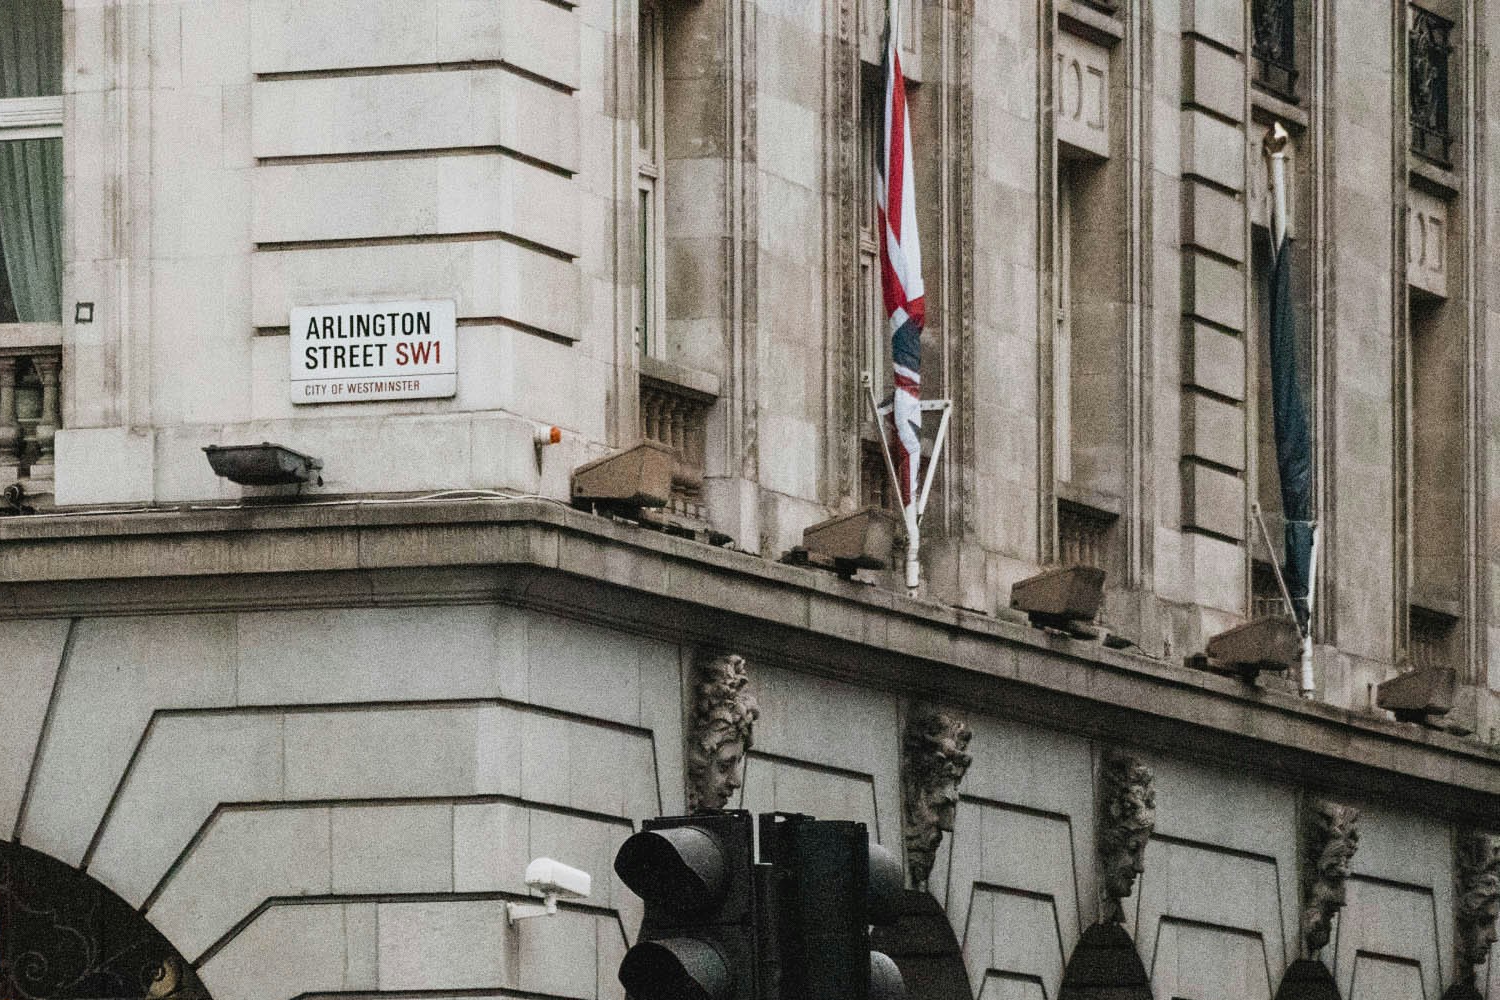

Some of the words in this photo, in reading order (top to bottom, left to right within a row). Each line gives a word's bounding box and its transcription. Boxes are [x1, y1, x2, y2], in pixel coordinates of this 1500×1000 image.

[306, 311, 431, 340] ARLINGTON
[305, 343, 387, 369] STREET
[395, 340, 441, 366] SW1
[305, 384, 327, 396] CITY
[331, 383, 343, 396] OF
[348, 380, 420, 394] WESTMINSTER
